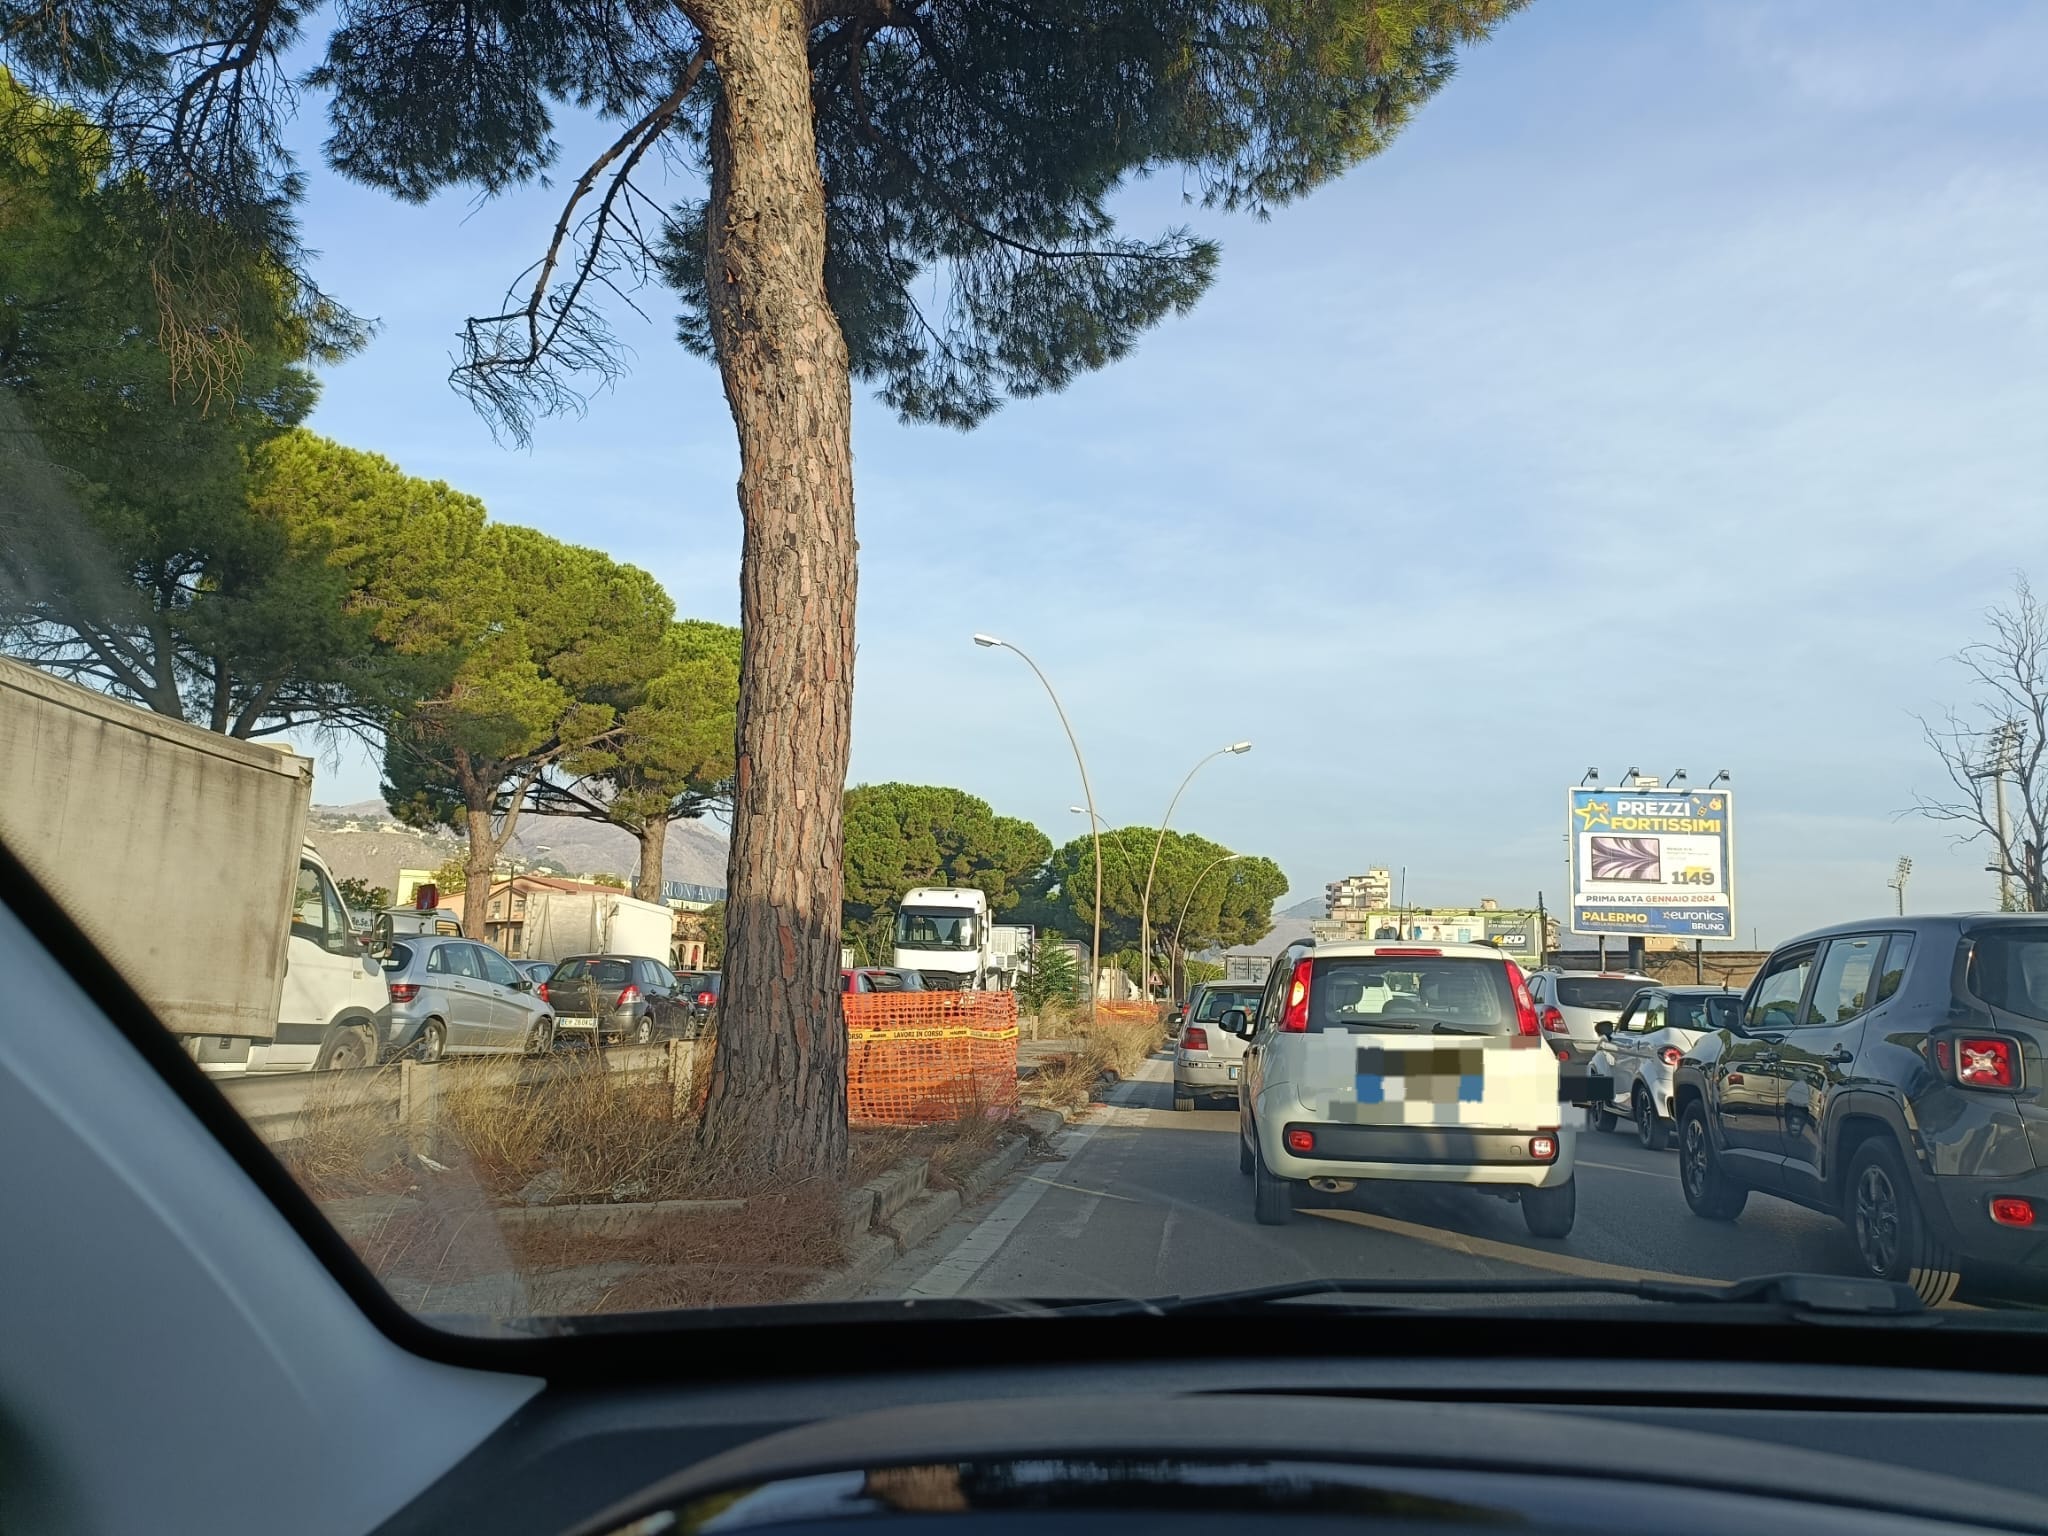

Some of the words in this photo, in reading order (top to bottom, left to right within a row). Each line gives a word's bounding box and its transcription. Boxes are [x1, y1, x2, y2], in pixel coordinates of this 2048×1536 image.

[1617, 801, 1691, 817] PREZZI
[1611, 817, 1721, 833] FORTISSIMI
[1671, 870, 1715, 886] 1149
[1586, 895, 1616, 903] PRIMA
[1618, 895, 1643, 903] RATA
[1690, 895, 1716, 903] 2024
[1582, 911, 1648, 923] PALERMO
[1670, 909, 1724, 921] euronics
[1691, 922, 1725, 931] BRUNO
